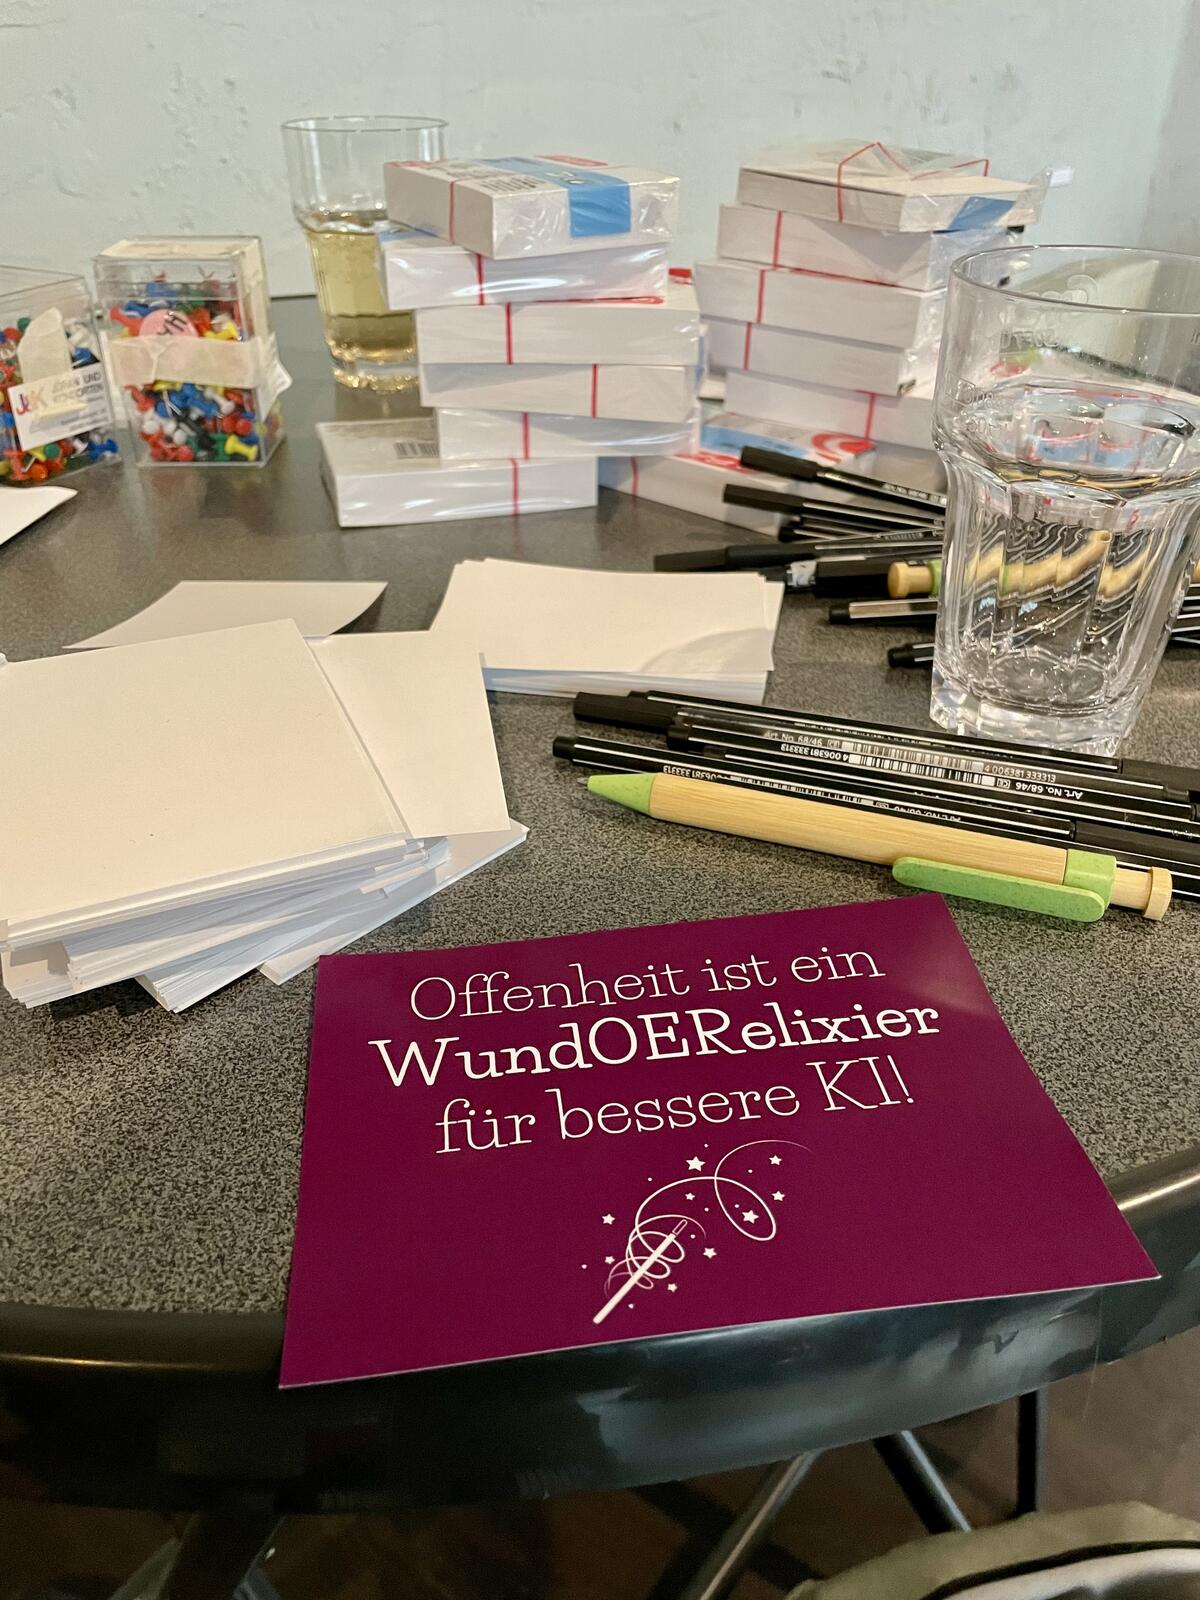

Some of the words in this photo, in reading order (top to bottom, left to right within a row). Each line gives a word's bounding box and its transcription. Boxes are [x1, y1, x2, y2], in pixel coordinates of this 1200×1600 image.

[797, 736, 823, 747] 68/46
[780, 743, 811, 756] 333313
[810, 748, 842, 761] 006381
[991, 766, 1024, 778] 006381
[1025, 771, 1057, 783] 333313
[1015, 781, 1044, 794] 68/46
[410, 962, 691, 1021] Offenheit
[703, 956, 778, 995] ist
[790, 946, 887, 983] ein
[367, 1001, 941, 1087] WundOERelixier
[435, 1098, 537, 1154] für
[544, 1085, 801, 1140] bessere
[805, 1054, 915, 1111] KI!
